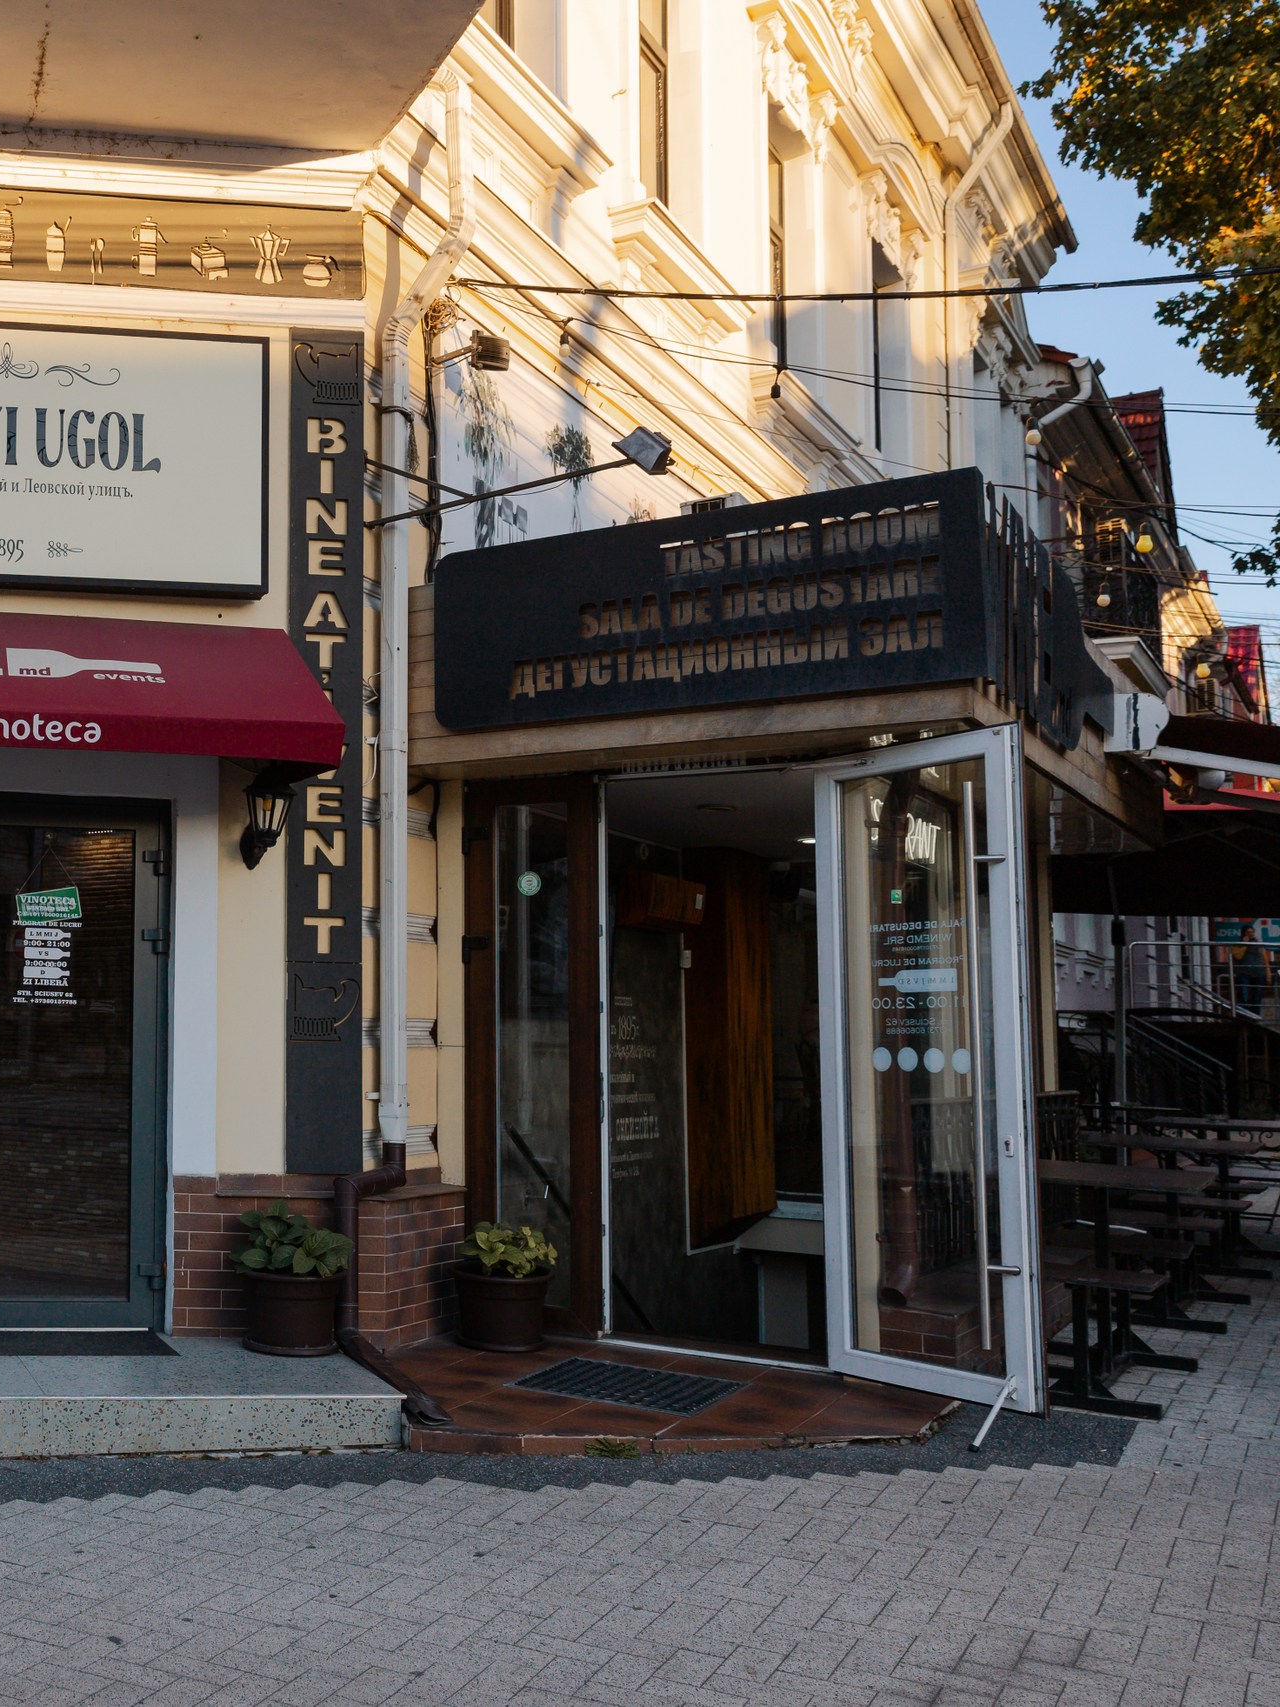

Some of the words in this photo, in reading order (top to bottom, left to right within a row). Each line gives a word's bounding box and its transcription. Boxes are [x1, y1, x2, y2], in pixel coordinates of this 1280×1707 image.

[34, 407, 162, 474] UGOL
[11, 482, 19, 492] и
[22, 477, 85, 496] Леовской
[88, 485, 133, 500] улицъ.
[306, 416, 348, 576] BINE
[660, 521, 812, 577] TASTING
[821, 500, 939, 557] ROOM
[578, 592, 661, 639] SALA
[669, 586, 712, 627] DE
[721, 555, 941, 621] DEGUSTARE
[19, 667, 51, 676] md
[93, 673, 166, 684] events
[510, 622, 849, 700] ДЕГУСТАЦИОННЫЙ
[858, 609, 944, 658] ЗАЛ
[34, 977, 68, 986] LIBERĂ
